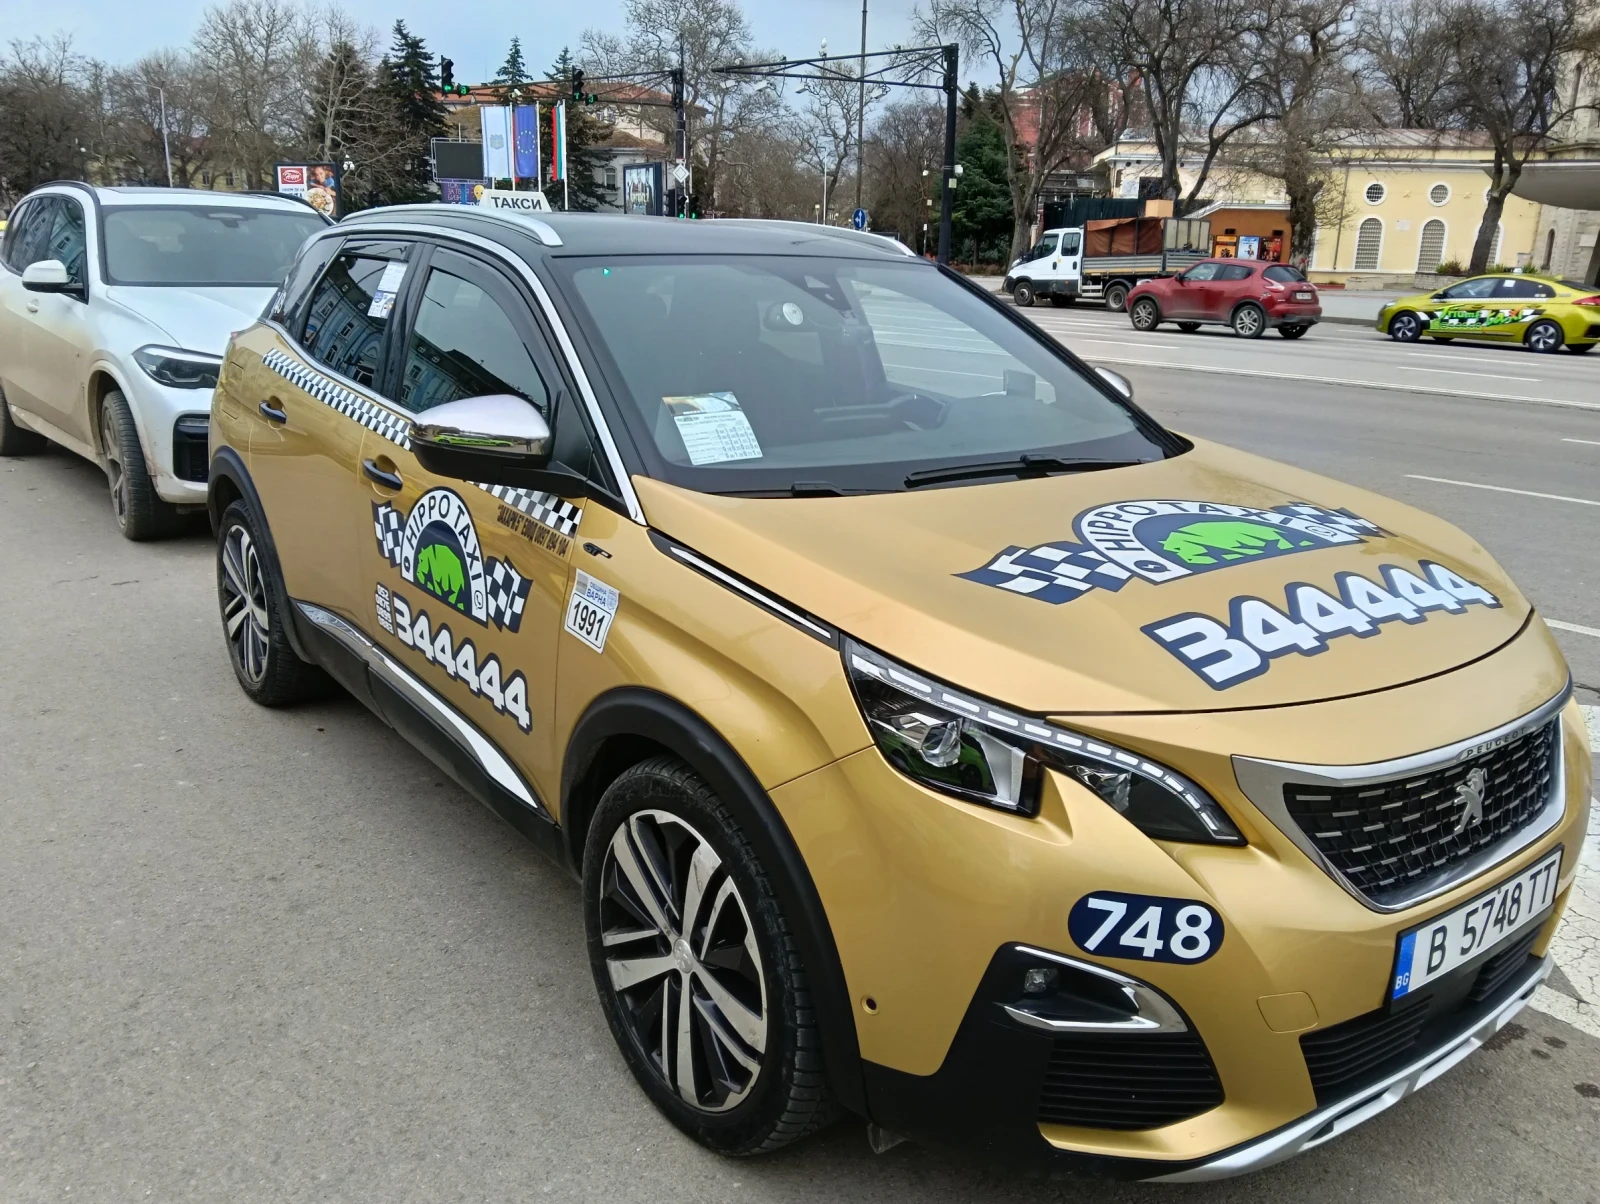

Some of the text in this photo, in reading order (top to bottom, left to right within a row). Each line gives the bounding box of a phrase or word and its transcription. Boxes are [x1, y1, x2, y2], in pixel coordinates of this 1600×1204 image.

[490, 196, 542, 210] ТАКСИ
[406, 494, 482, 581] HIPPO TAXI
[1086, 501, 1294, 552] HIPPO TAXI
[573, 600, 605, 642] 1991
[586, 588, 606, 607] ВАРНА
[1148, 562, 1500, 687] 344444
[392, 595, 531, 731] 344444
[1466, 726, 1527, 758] PEUGEOT
[1083, 897, 1213, 960] 748
[1425, 858, 1557, 977] B 5748 TT
[1394, 972, 1410, 991] BG
